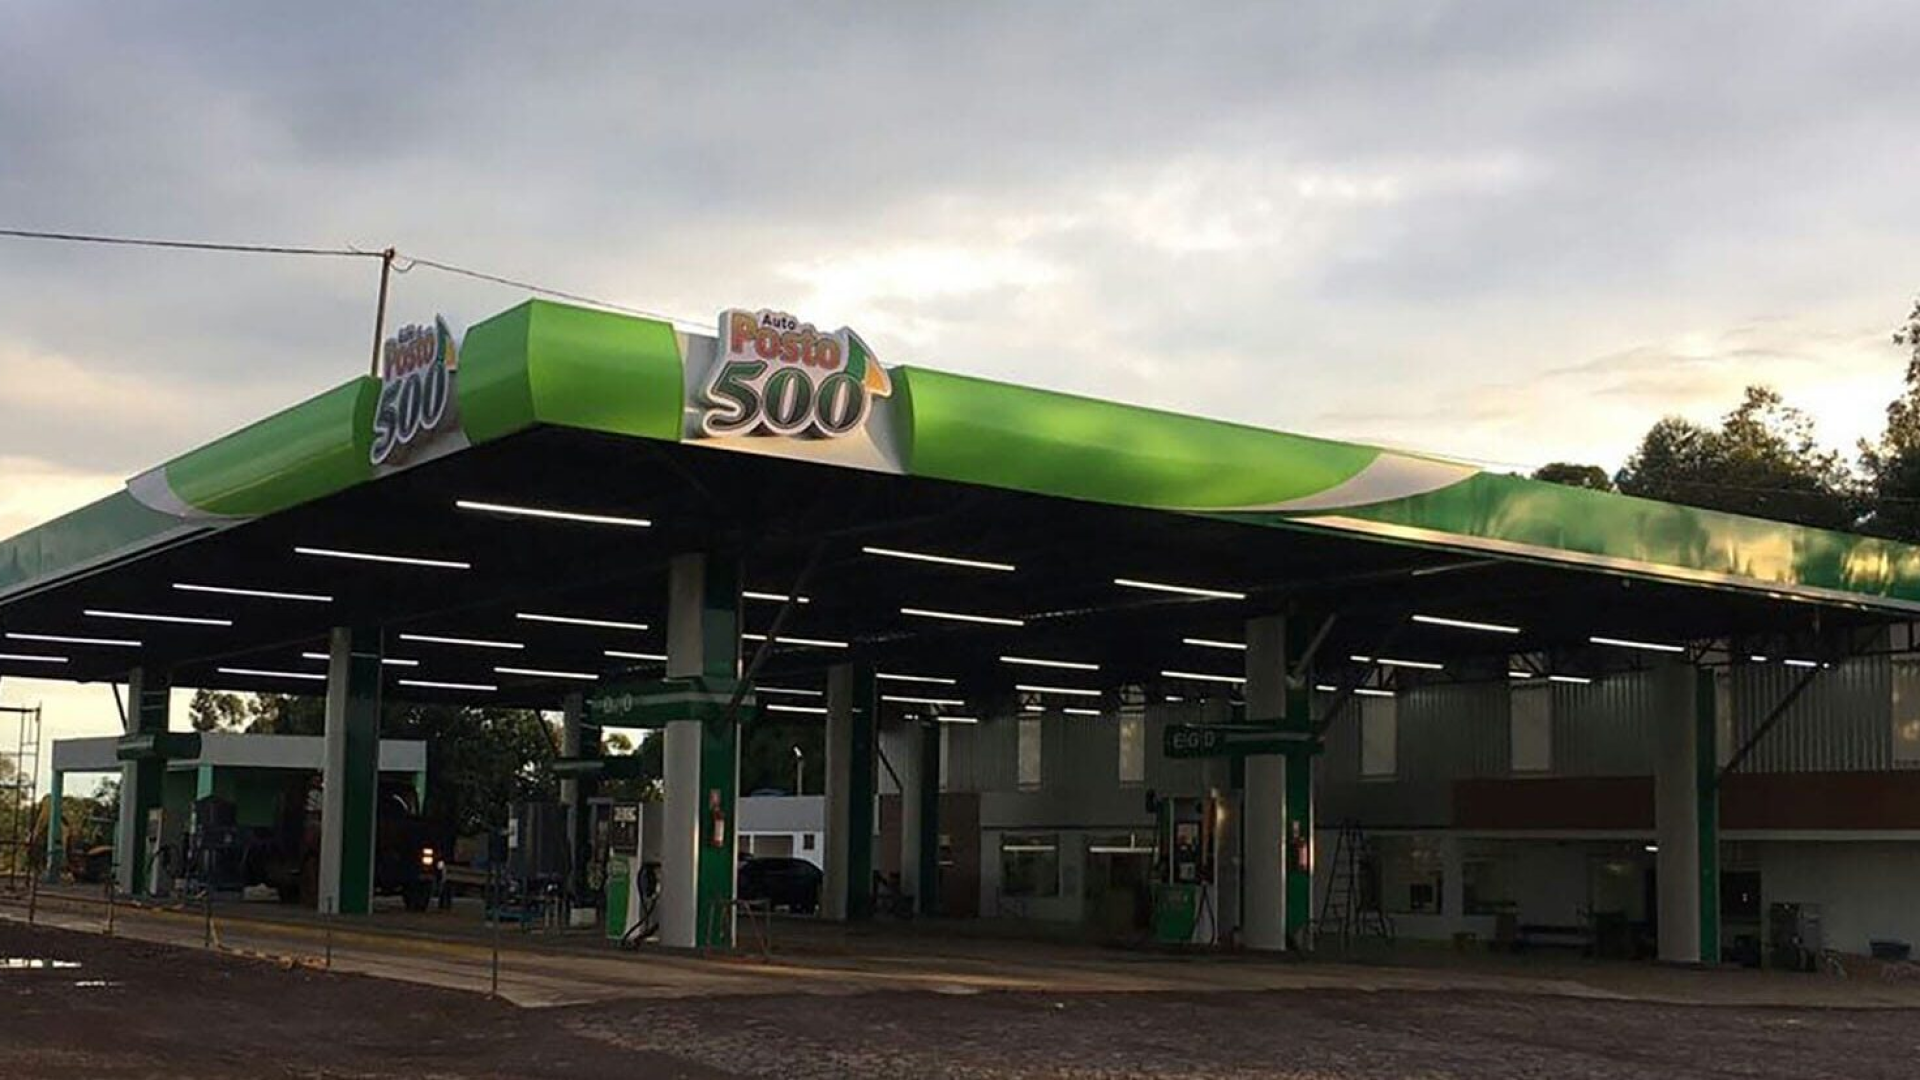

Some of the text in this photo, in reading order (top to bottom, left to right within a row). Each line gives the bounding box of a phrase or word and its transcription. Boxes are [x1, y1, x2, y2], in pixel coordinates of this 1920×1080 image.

[731, 312, 840, 370] Posto
[762, 314, 796, 331] Auto
[371, 373, 447, 463] 500
[705, 360, 866, 433] 500
